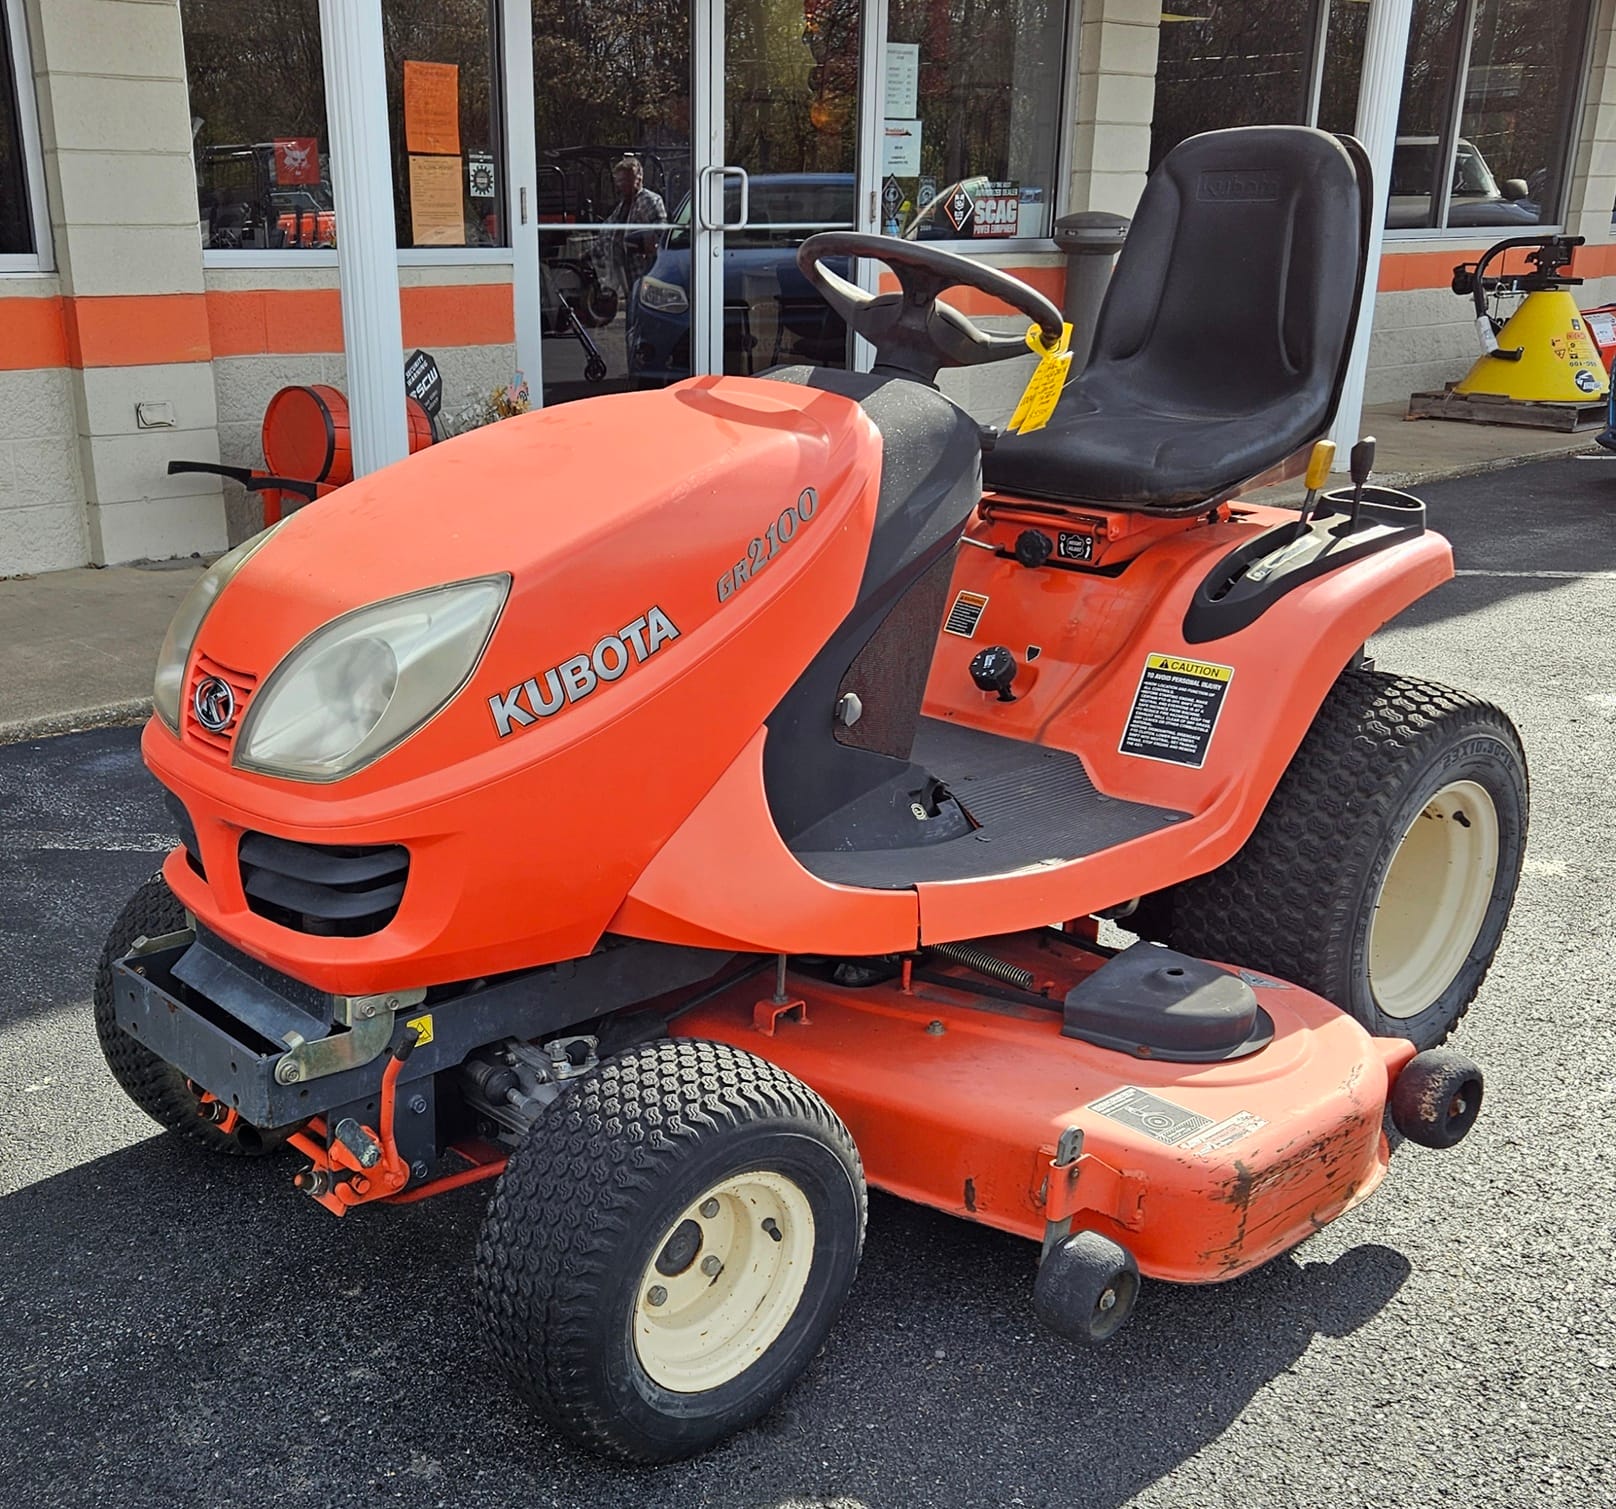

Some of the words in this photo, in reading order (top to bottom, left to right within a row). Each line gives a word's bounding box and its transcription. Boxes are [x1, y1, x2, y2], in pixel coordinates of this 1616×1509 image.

[974, 199, 1018, 225] SCAG
[717, 487, 819, 603] GR2100
[488, 604, 682, 738] KUBOTA
[1155, 673, 1171, 681] AVOID
[1172, 677, 1201, 686] PERSONAL
[1201, 682, 1222, 690] INJURY
[1171, 661, 1220, 677] CAUTION
